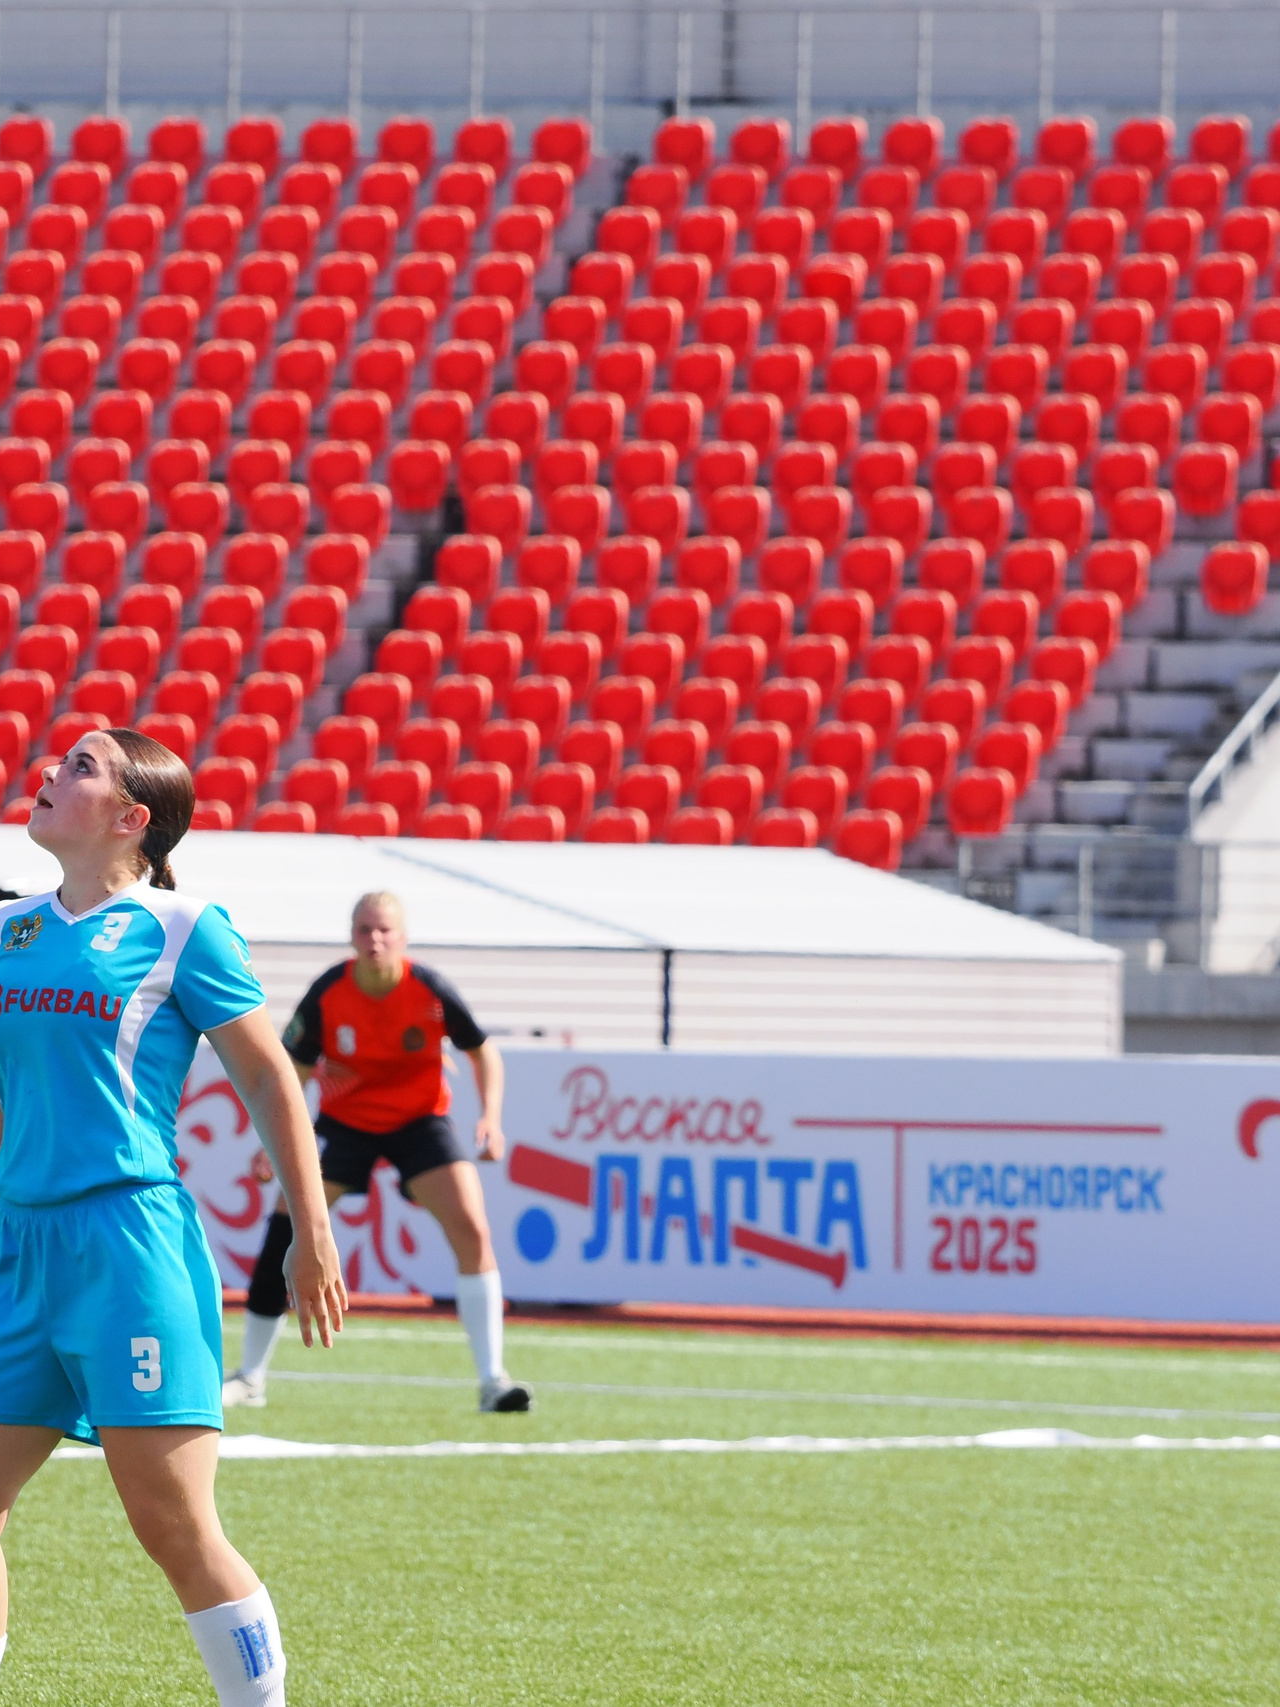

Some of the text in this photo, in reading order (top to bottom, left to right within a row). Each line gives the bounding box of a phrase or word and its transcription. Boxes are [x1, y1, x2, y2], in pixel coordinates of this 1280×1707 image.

[90, 912, 133, 952] 3
[4, 988, 122, 1022] FURBAU
[582, 1154, 869, 1271] ЛАПТА
[927, 1162, 1166, 1213] КРАСНОЯРСК
[930, 1215, 1038, 1274] 2025
[130, 1336, 162, 1392] 3
